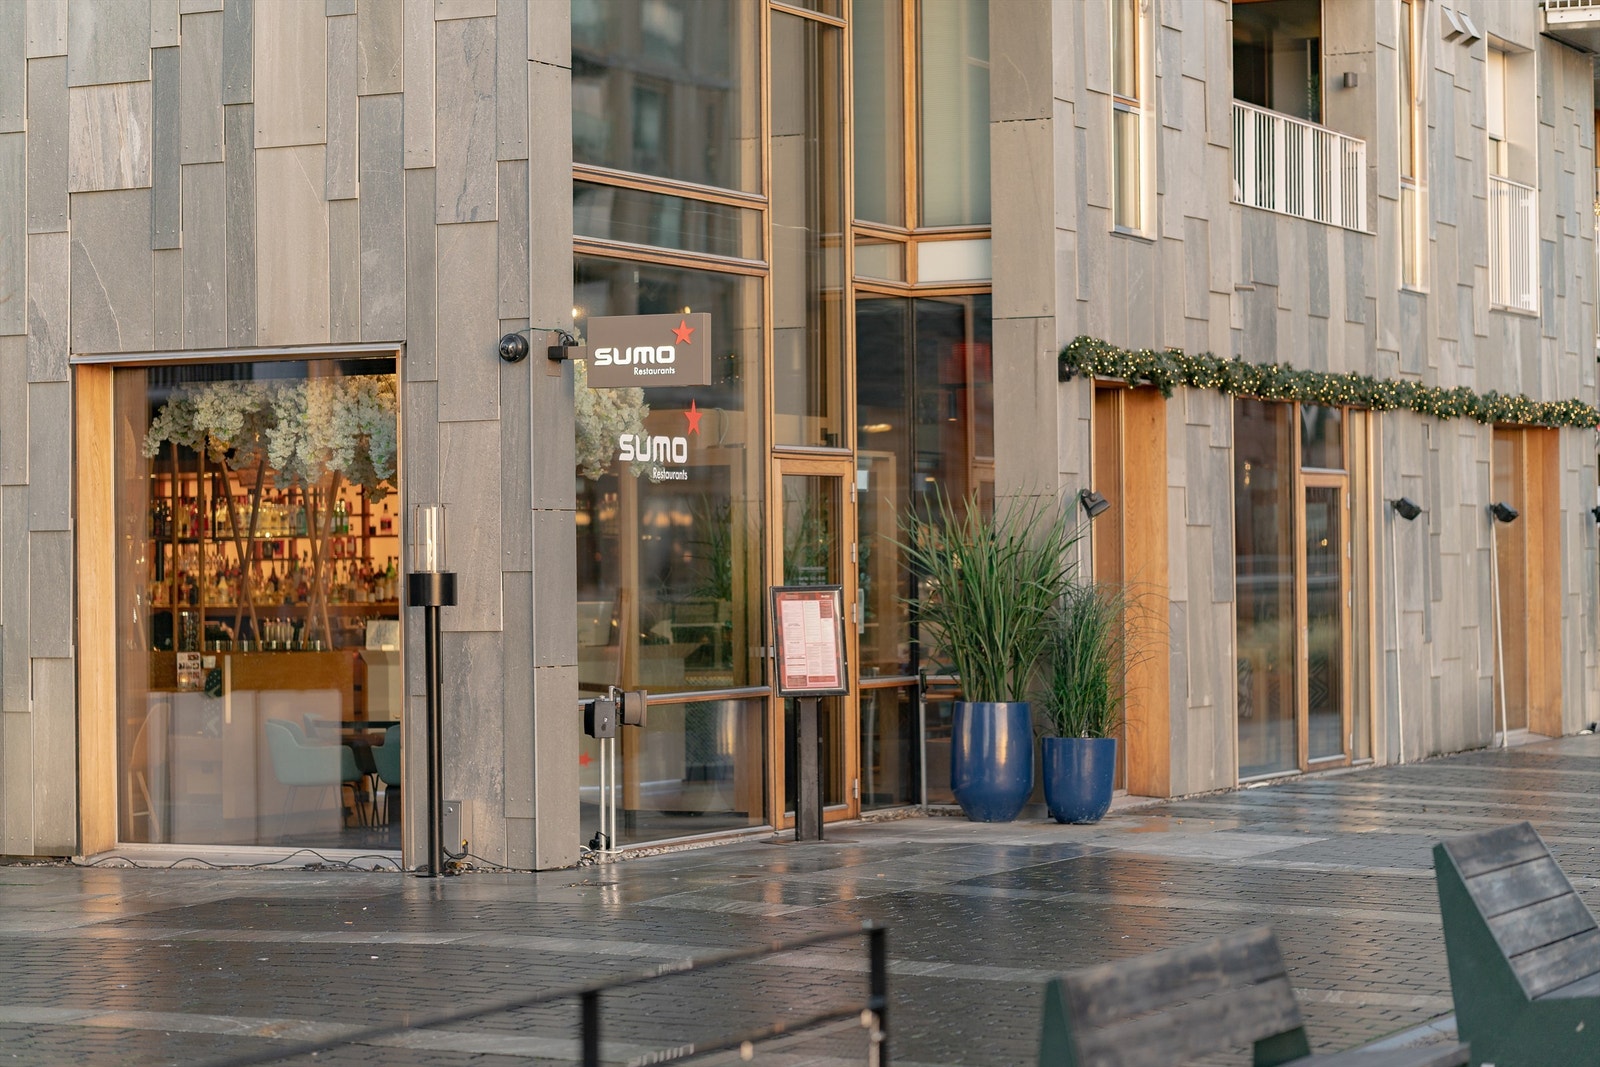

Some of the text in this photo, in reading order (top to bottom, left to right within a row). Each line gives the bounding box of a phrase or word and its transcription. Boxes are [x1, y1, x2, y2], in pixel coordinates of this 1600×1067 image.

[594, 345, 675, 366] SUMO
[633, 366, 675, 376] Restaurants
[618, 434, 688, 463] SUMO
[652, 467, 688, 480] Restaurants
